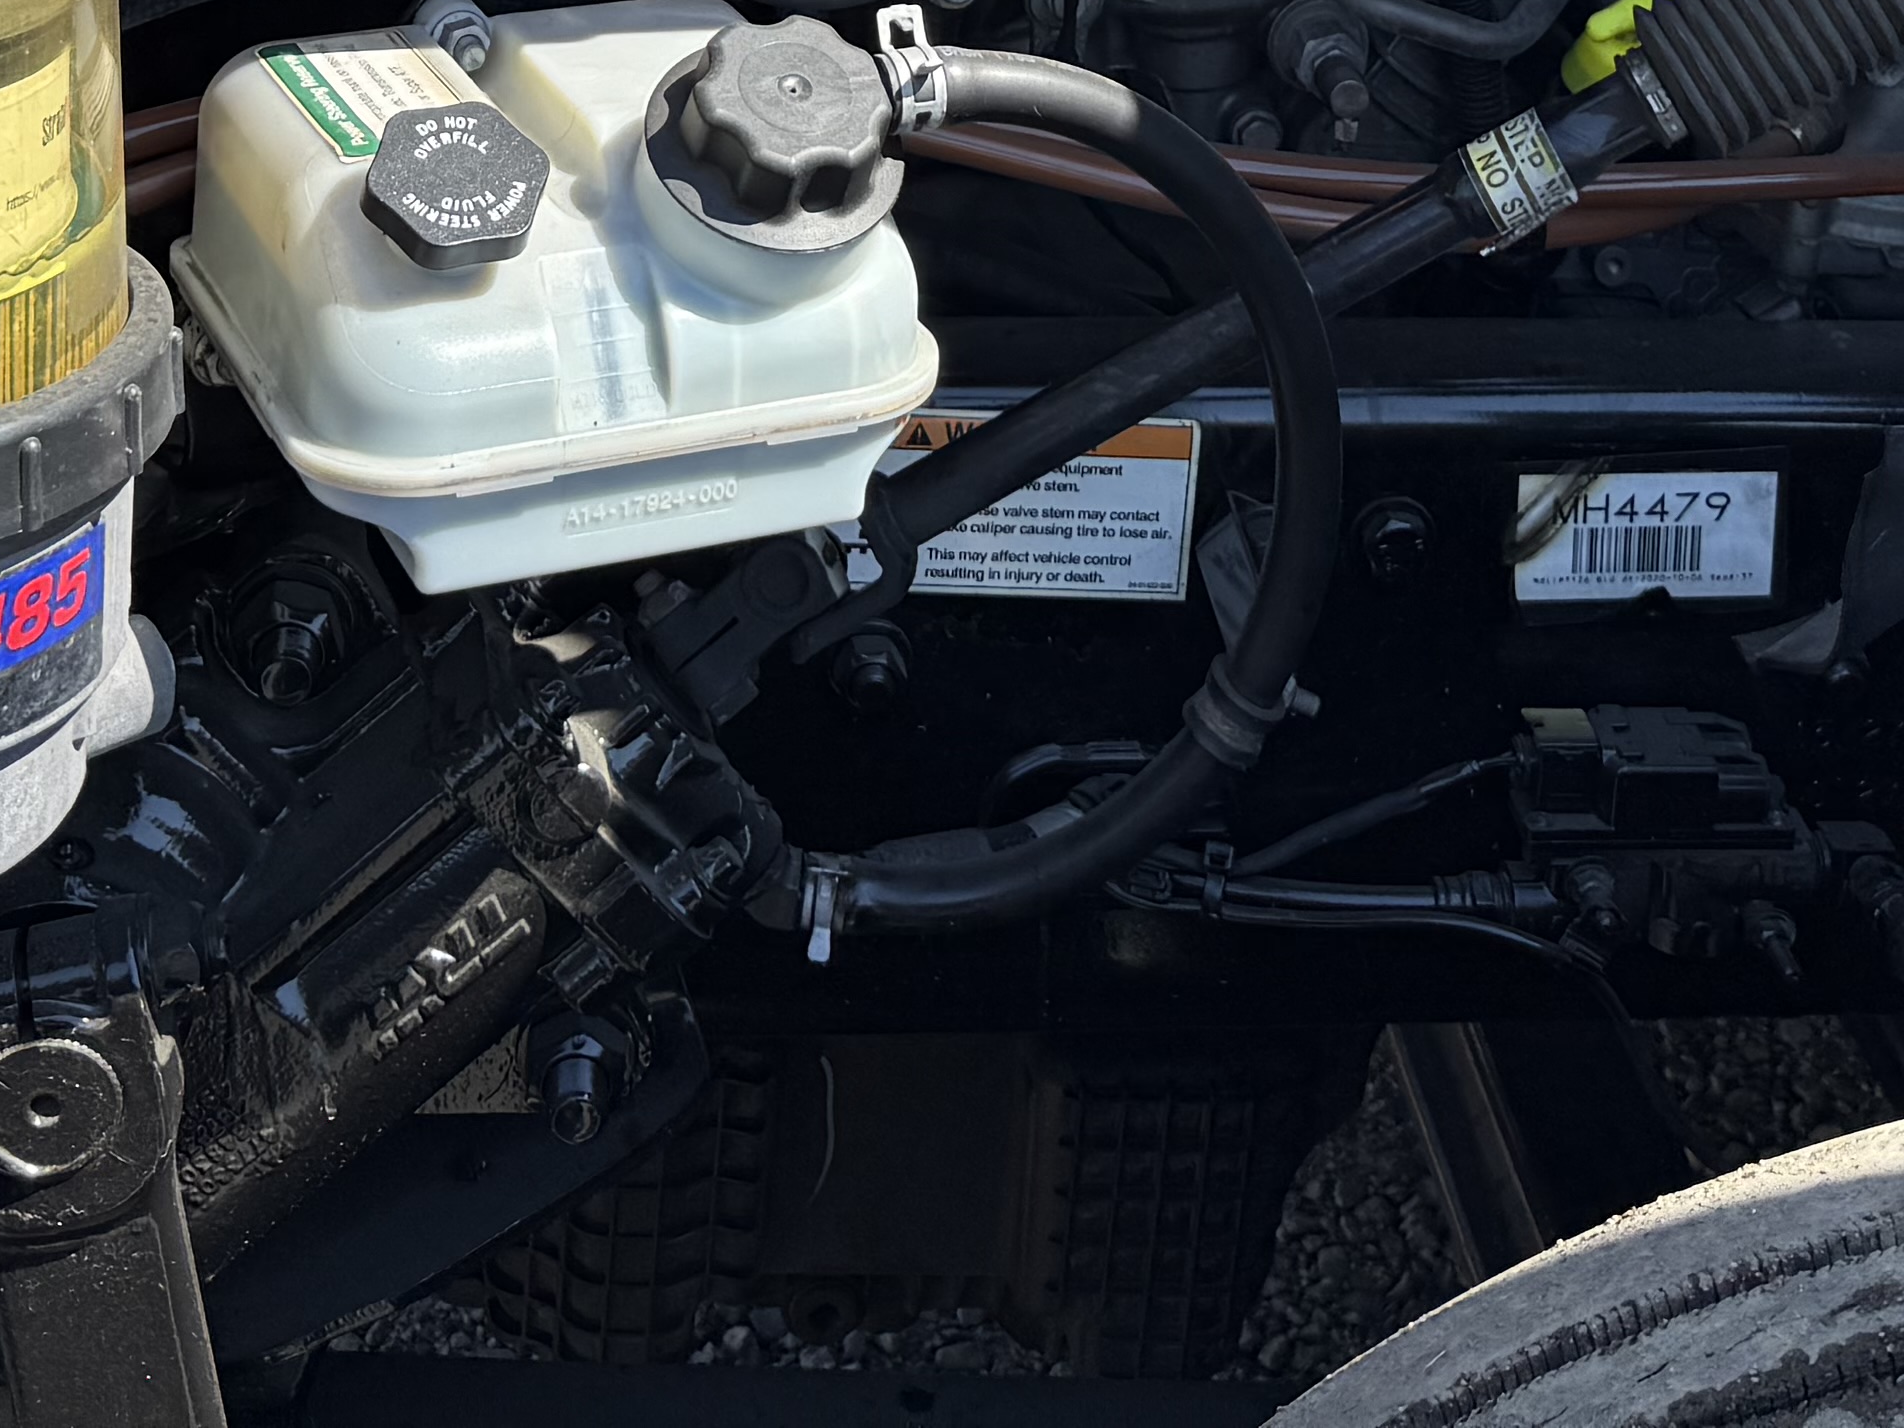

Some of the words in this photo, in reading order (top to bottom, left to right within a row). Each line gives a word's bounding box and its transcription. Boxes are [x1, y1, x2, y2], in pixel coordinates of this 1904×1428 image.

[415, 119, 438, 136] DO
[444, 116, 478, 132] NOT
[414, 131, 488, 160] OVERFILL
[1476, 149, 1509, 188] NO
[402, 192, 481, 229] STEERING
[441, 190, 496, 214] FLUID
[487, 180, 527, 223] POWER
[1044, 479, 1081, 493] stem.
[566, 479, 739, 527] A14-17924-000
[1003, 505, 1039, 518] valve
[1041, 507, 1075, 520] stem
[1077, 509, 1107, 523] may
[1110, 508, 1160, 523] contact
[1552, 491, 1731, 525] MH4479
[970, 521, 1016, 537] caliper
[1019, 523, 1073, 539] causing
[1076, 523, 1099, 537] tire
[1102, 525, 1116, 538] to
[1119, 526, 1148, 540] lose
[1151, 527, 1173, 541] air.
[927, 547, 955, 562] This
[958, 549, 987, 564] may
[991, 548, 1030, 563] affect
[1032, 550, 1081, 565] vehicle
[1083, 552, 1132, 567] control
[924, 565, 984, 582] resulting
[988, 567, 1001, 580] in
[1004, 567, 1041, 584] injury
[1045, 571, 1060, 583] or
[1063, 569, 1105, 584] death.
